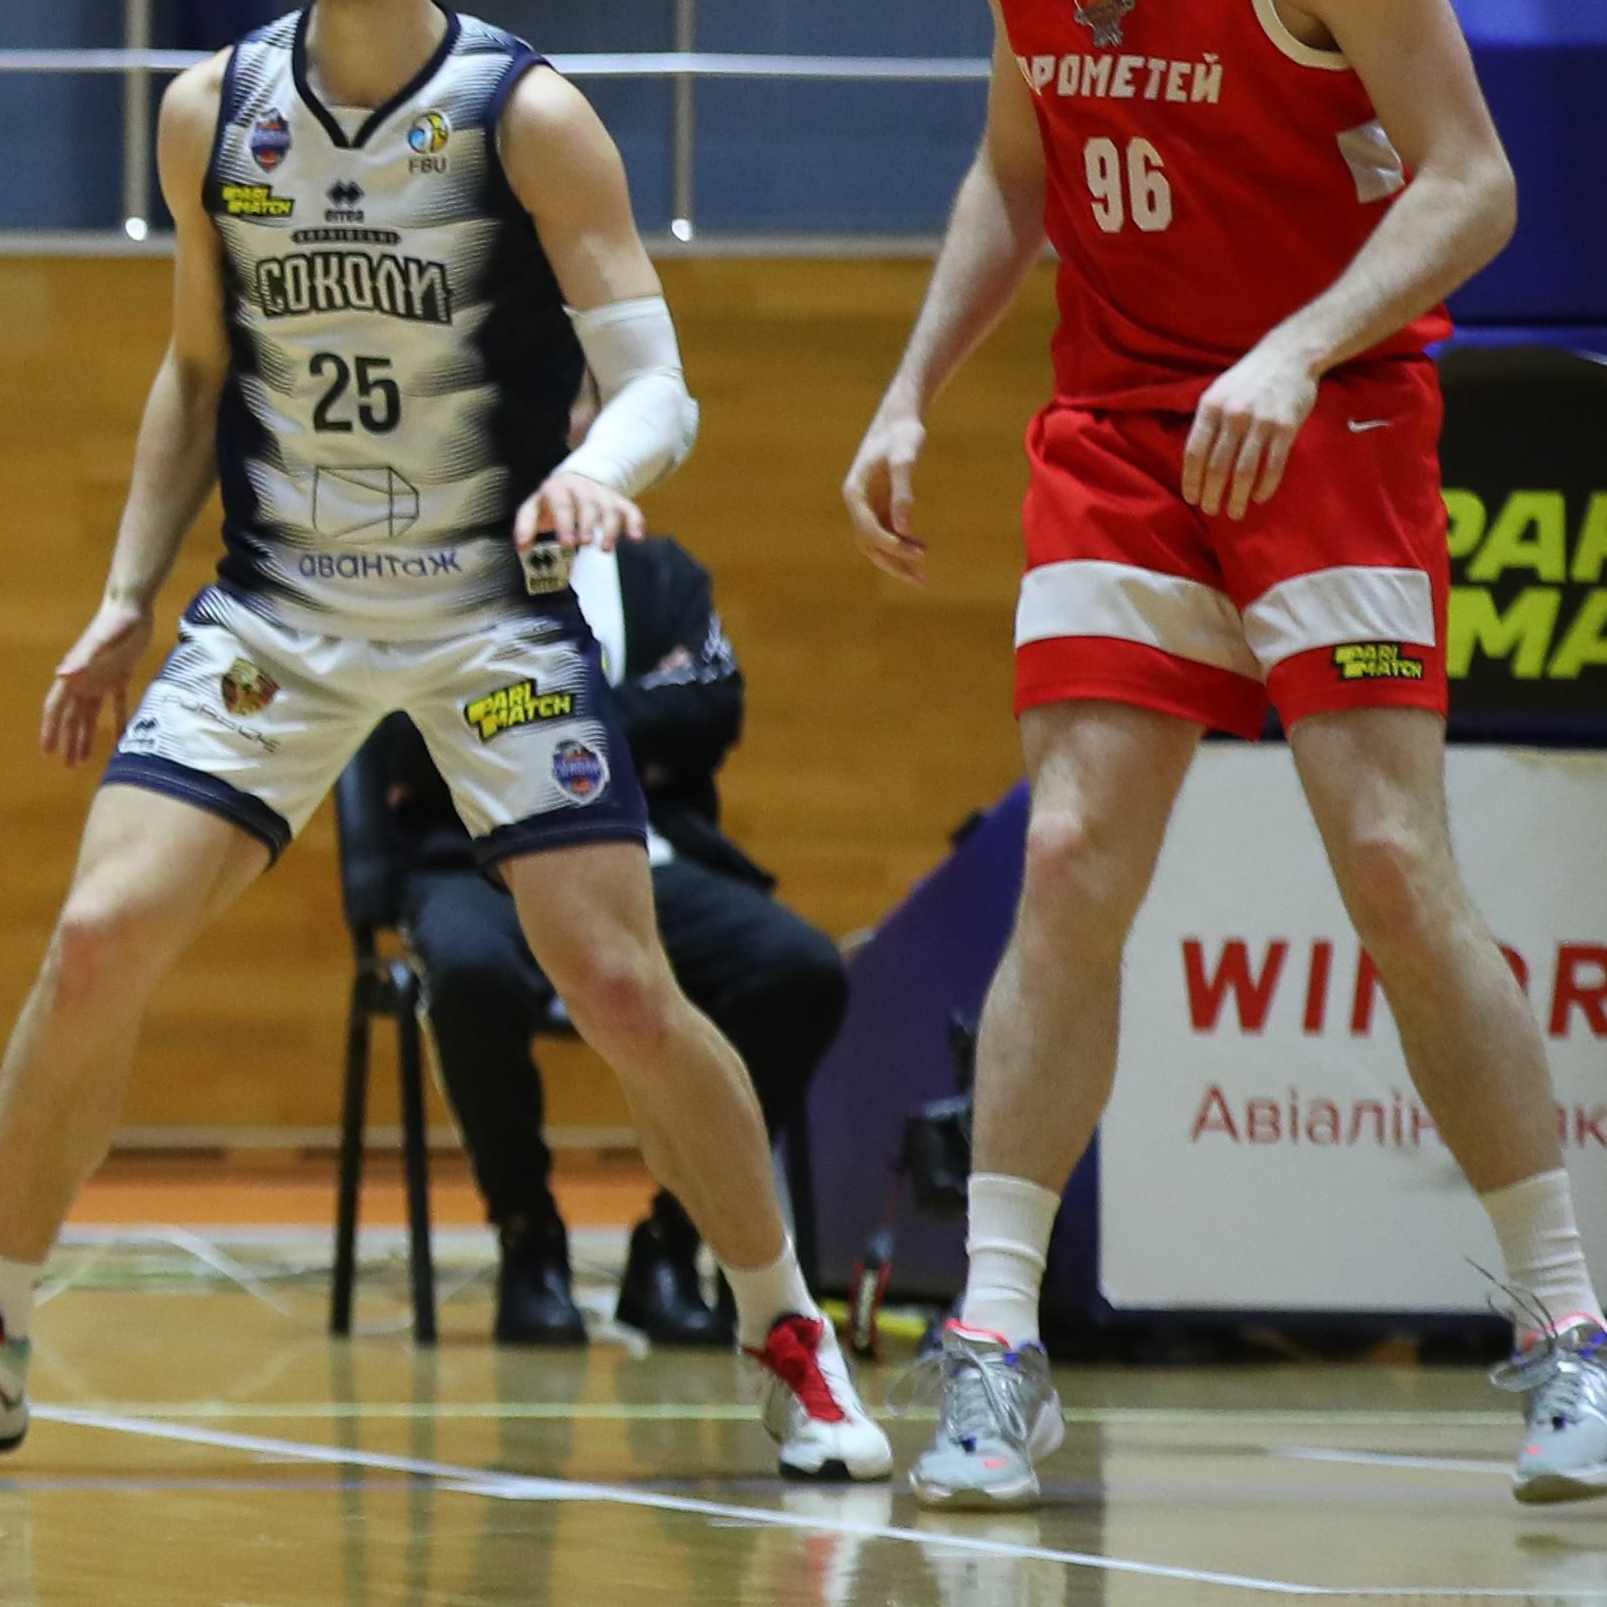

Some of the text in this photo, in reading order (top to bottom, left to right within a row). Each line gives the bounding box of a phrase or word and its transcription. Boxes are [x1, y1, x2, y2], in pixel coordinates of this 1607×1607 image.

[408, 156, 448, 174] FBU
[1083, 136, 1173, 233] 96
[308, 352, 402, 434] 25
[298, 551, 463, 579] авантаж
[1191, 1084, 1447, 1148] Авіалін
